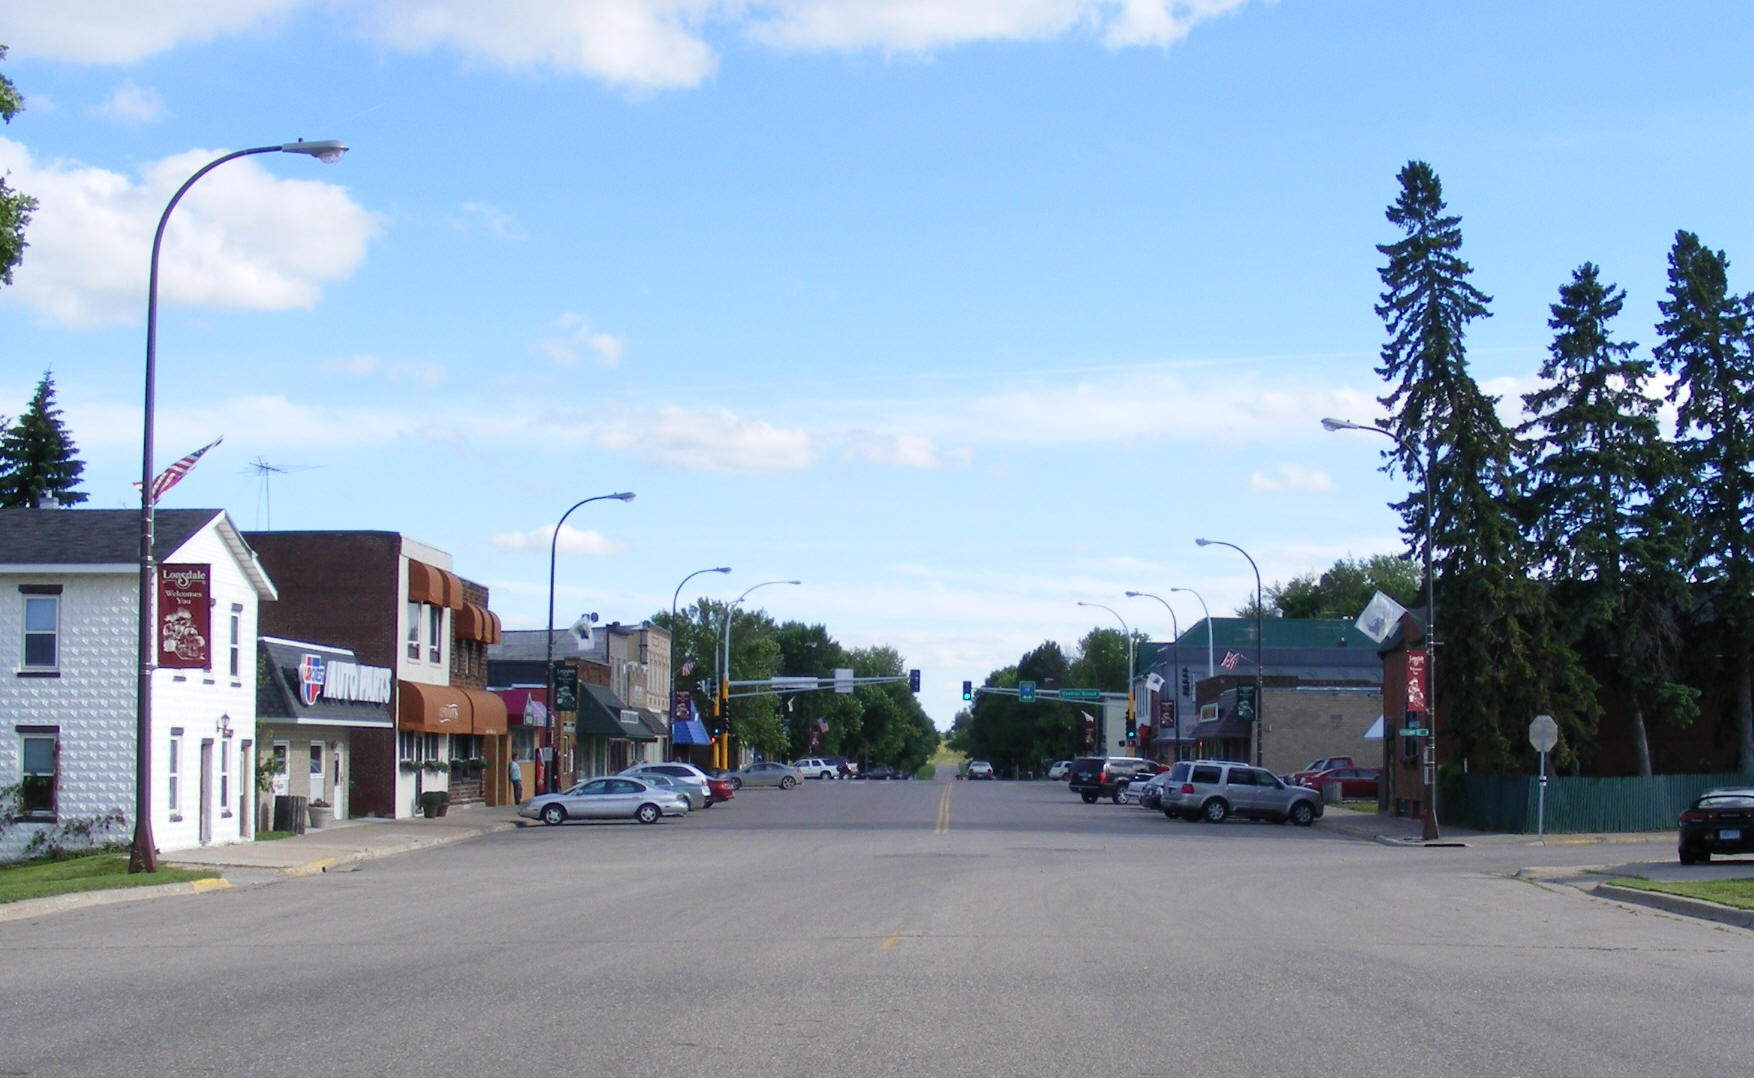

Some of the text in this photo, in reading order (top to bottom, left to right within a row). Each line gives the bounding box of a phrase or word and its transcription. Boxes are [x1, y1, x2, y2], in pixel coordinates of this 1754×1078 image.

[163, 570, 206, 587] Lonsdale
[323, 660, 393, 704] AUTO PARTS
